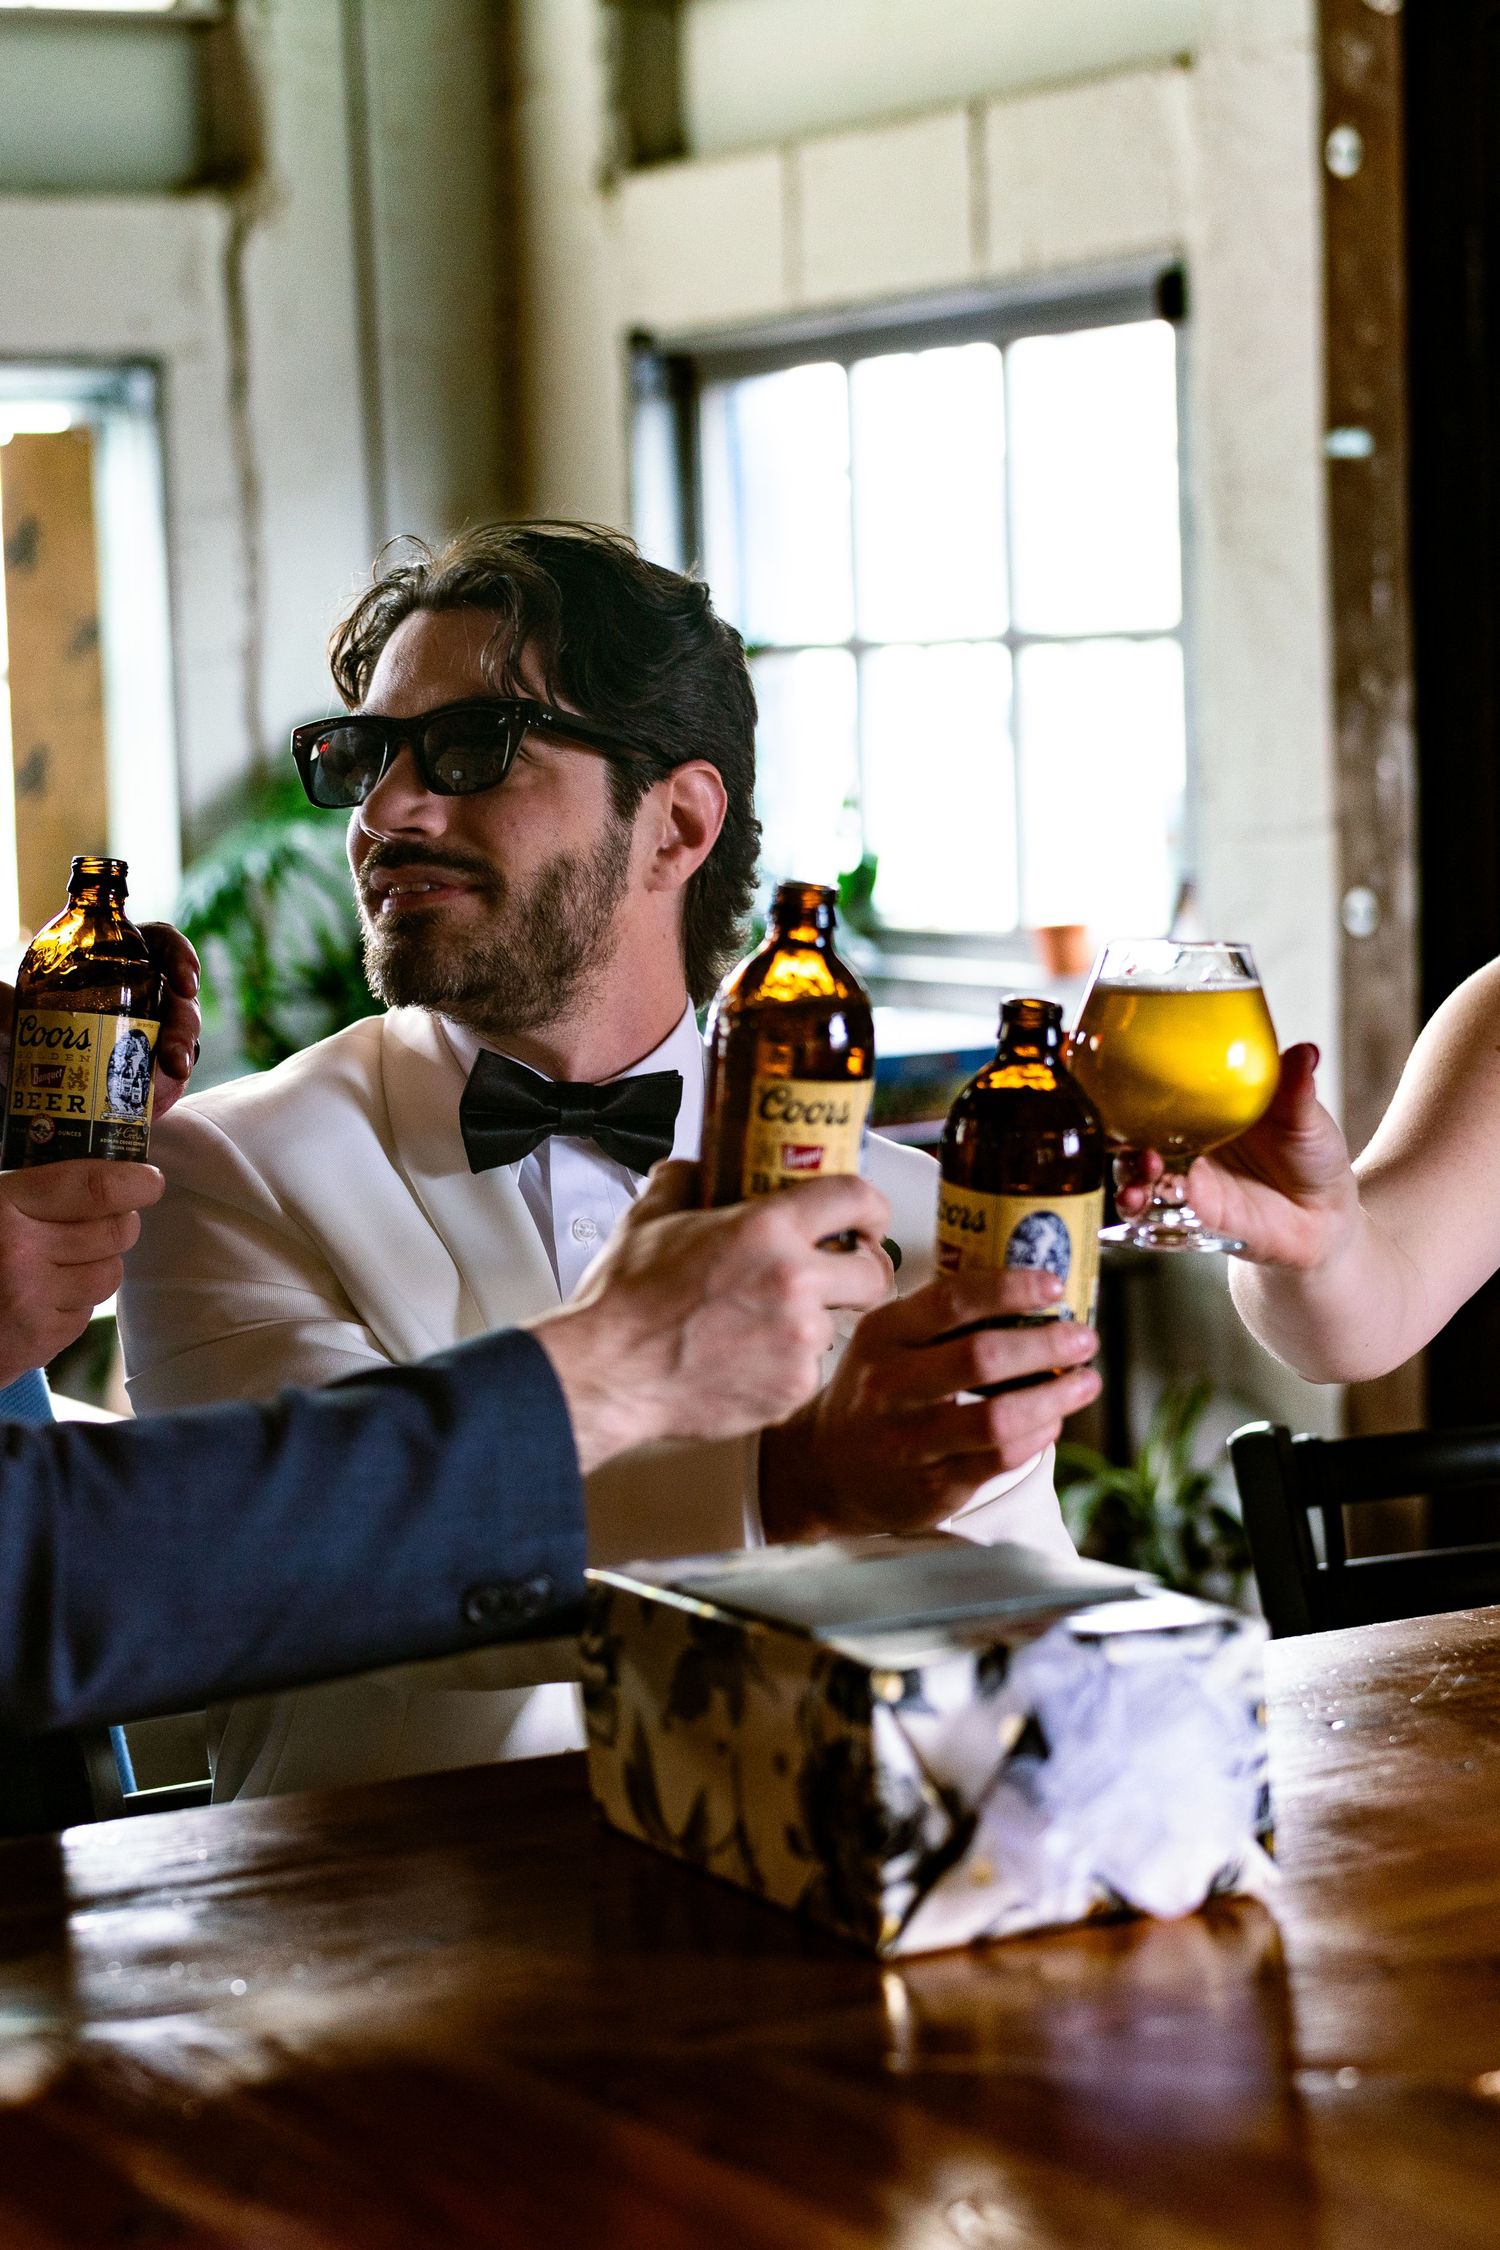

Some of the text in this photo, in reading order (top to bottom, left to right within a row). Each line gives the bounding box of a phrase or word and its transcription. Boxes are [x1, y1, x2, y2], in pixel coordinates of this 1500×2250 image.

[18, 1014, 92, 1050] Coors
[33, 1066, 63, 1085] Banquet
[13, 1090, 87, 1114] BEER
